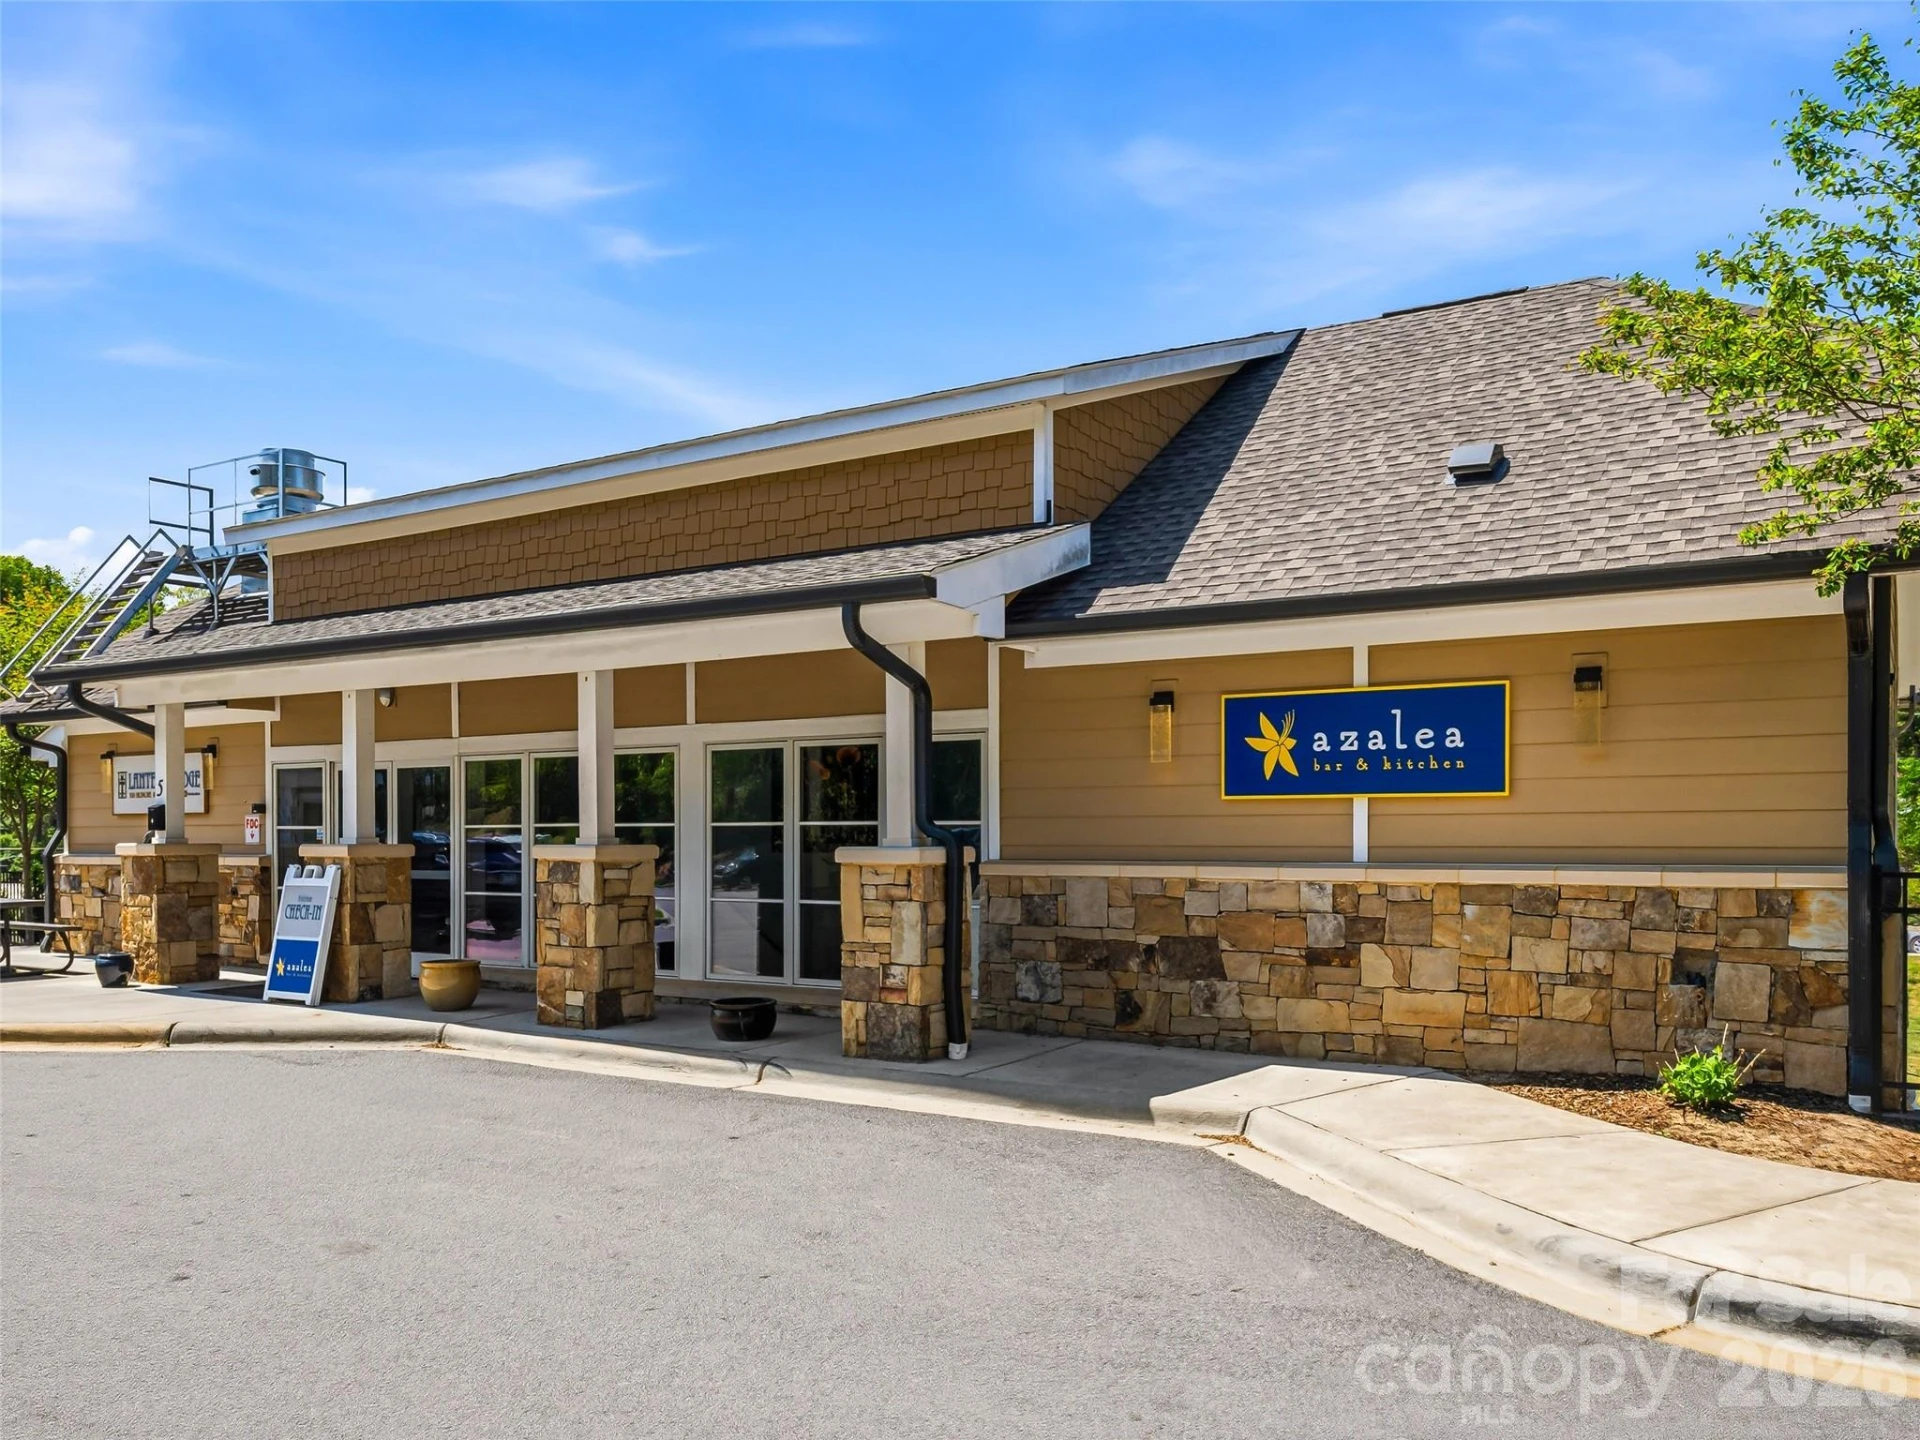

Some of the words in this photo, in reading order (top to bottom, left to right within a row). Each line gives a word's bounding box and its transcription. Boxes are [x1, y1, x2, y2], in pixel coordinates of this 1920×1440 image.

[1312, 709, 1465, 752] azalea
[1313, 758, 1343, 772] bar
[1356, 757, 1369, 771] &
[1383, 755, 1465, 770] kitchen
[156, 779, 164, 797] 5
[246, 818, 259, 829] FDC
[284, 904, 322, 920] CHECK-IN
